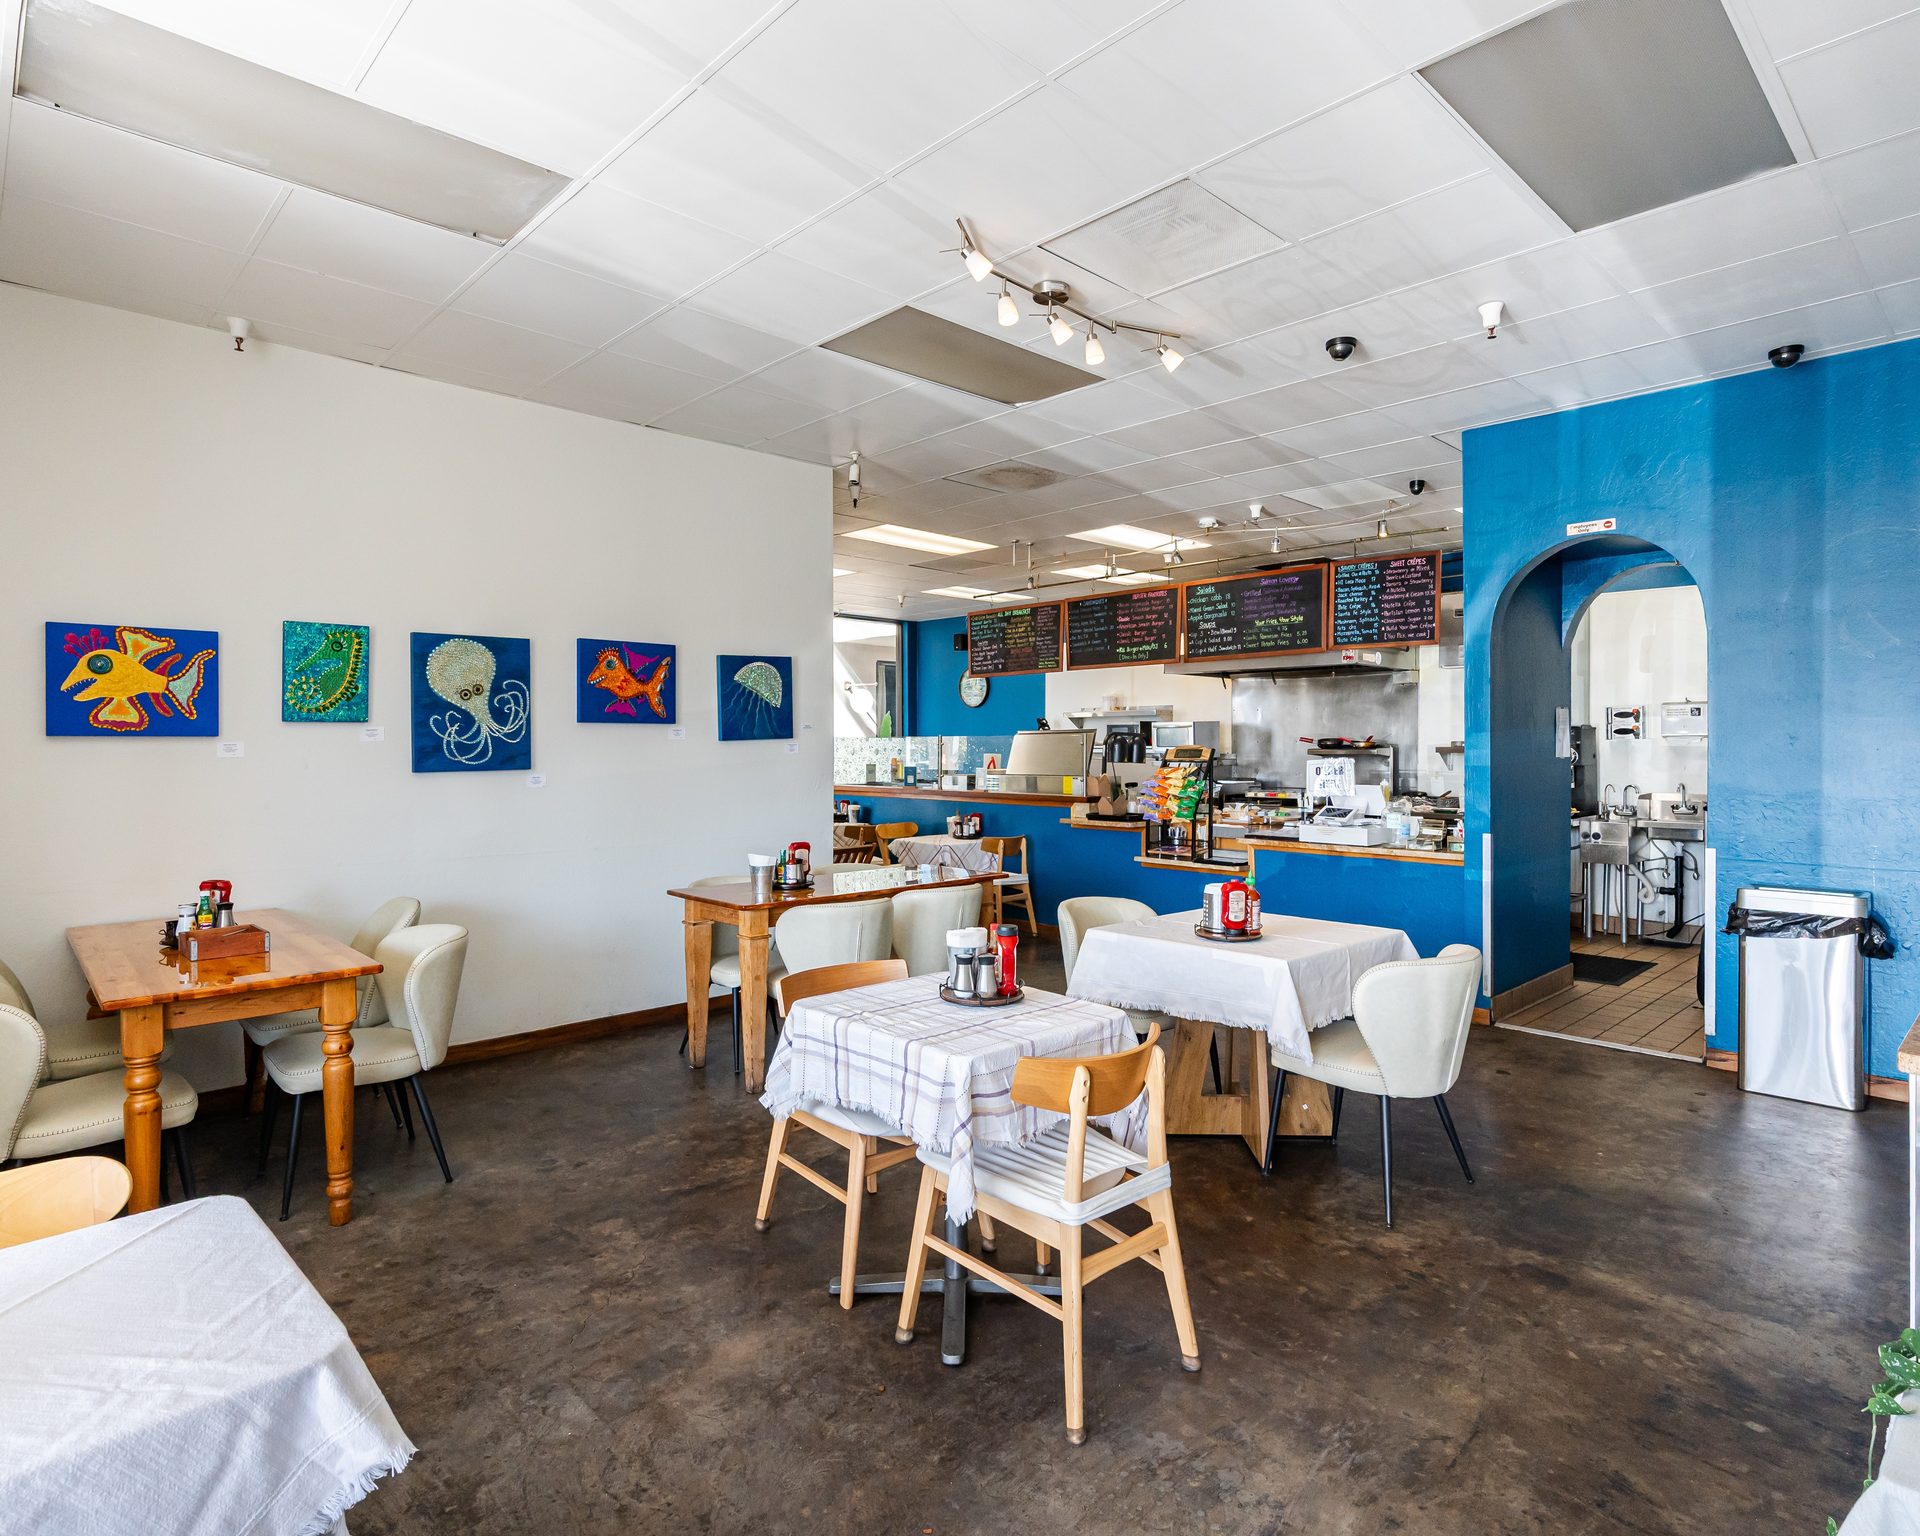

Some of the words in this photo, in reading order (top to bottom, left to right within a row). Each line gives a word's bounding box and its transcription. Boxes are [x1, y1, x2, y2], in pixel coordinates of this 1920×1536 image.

[1390, 559, 1405, 567] SWEET
[1196, 584, 1215, 594] Salads
[1290, 614, 1304, 624] Style
